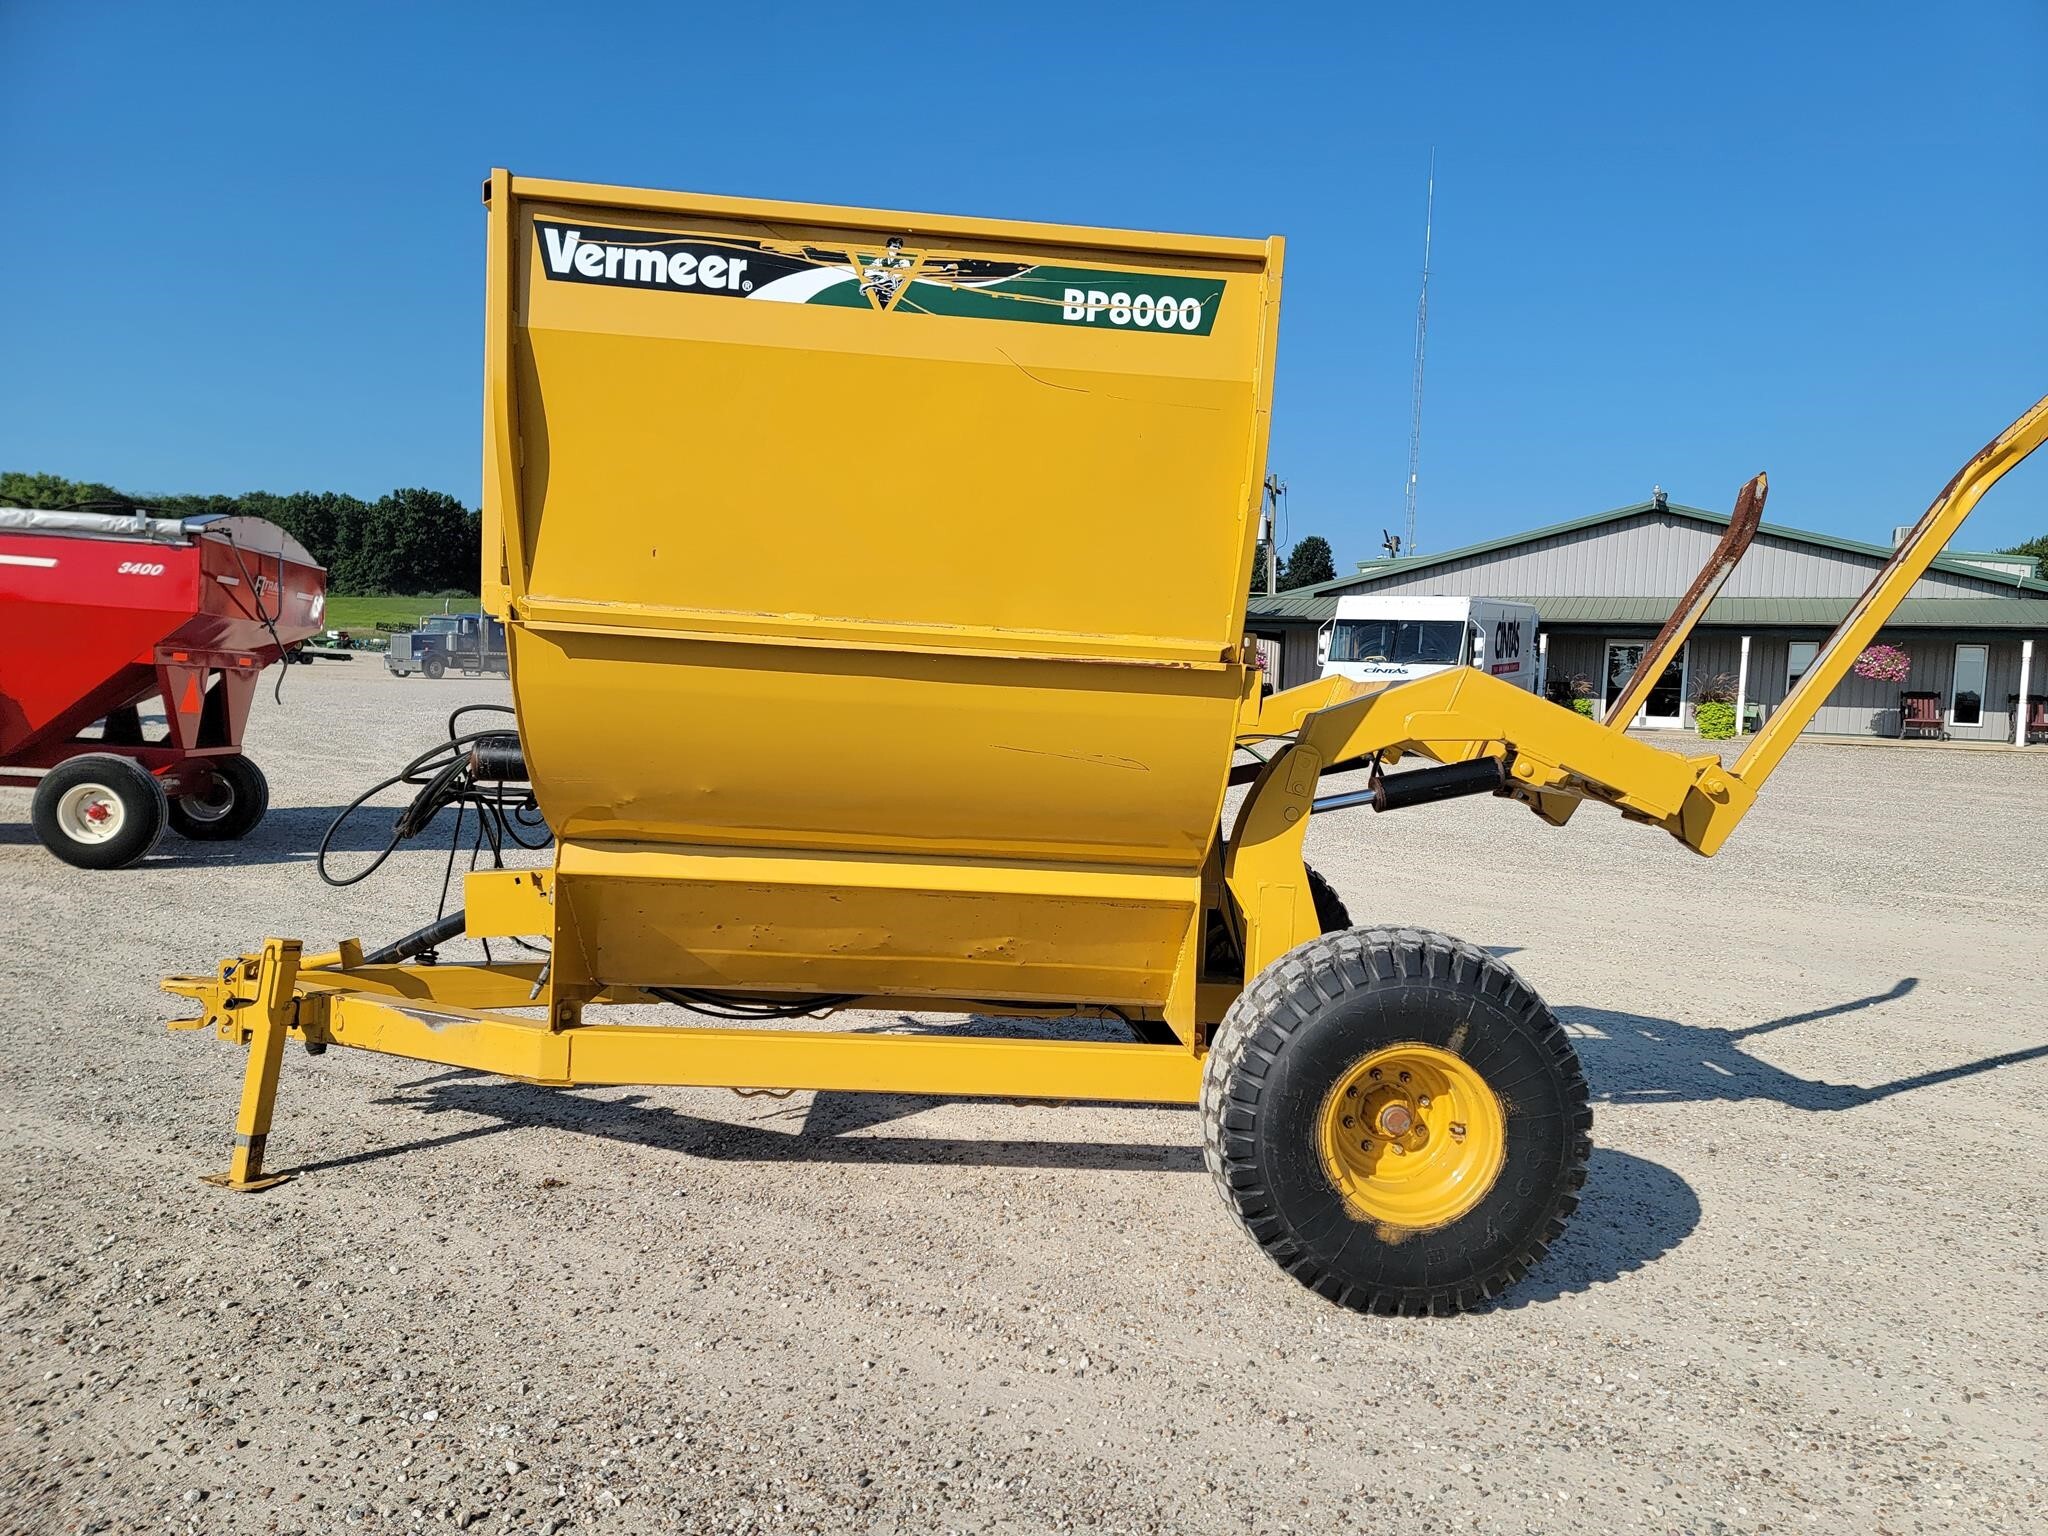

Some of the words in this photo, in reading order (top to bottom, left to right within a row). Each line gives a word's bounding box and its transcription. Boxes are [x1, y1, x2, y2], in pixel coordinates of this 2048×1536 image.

[544, 228, 747, 290] Vermeer
[1063, 288, 1202, 330] BP8000
[118, 561, 164, 576] 3400
[1363, 666, 1409, 674] CINTAS
